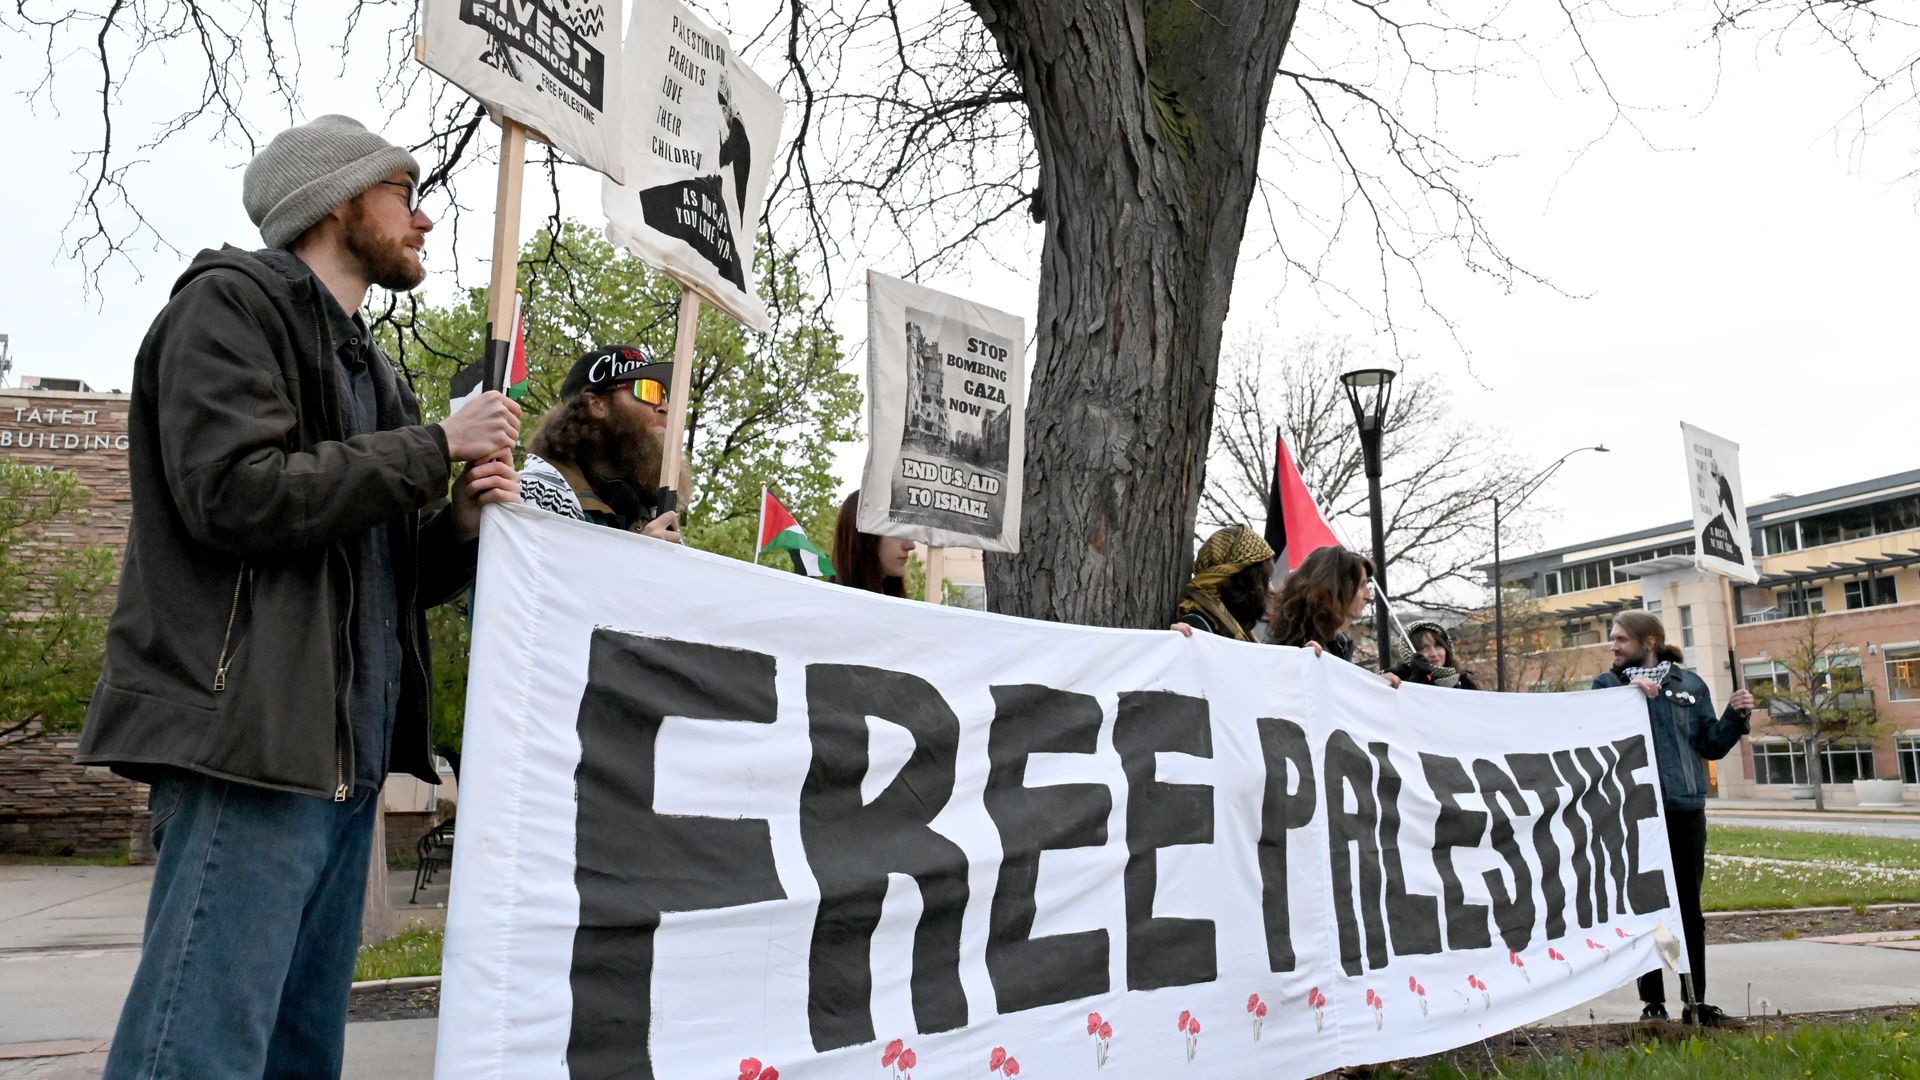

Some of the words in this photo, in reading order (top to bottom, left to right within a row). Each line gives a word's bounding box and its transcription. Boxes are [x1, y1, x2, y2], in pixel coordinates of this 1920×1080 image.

[473, 3, 521, 40] FROM
[524, 32, 592, 95] GENOCIDE
[484, 0, 592, 74] IVEST
[672, 15, 726, 67] PALESTINIAN
[668, 45, 706, 86] PARENTS
[541, 73, 557, 97] FREE
[558, 87, 595, 125] PALESTINE
[662, 75, 683, 105] LOVE
[656, 105, 682, 137] THEIR
[652, 135, 702, 171] CHILDREN
[683, 187, 698, 207] AS
[676, 206, 697, 228] YOU
[967, 337, 1008, 363] STOP
[946, 354, 1007, 383] BOMBING
[949, 397, 981, 417] NOW
[963, 380, 1006, 405] GAZA
[14, 407, 73, 424] TATE
[82, 410, 98, 425] II
[0, 430, 130, 450] BUILDING
[902, 458, 939, 482] END
[940, 465, 966, 489] U.S.
[968, 473, 1000, 496] AID
[907, 486, 932, 507] TO
[933, 490, 989, 520] ISRAEL
[565, 625, 1218, 1080] FREE
[1256, 717, 1671, 976] PALESTINE
